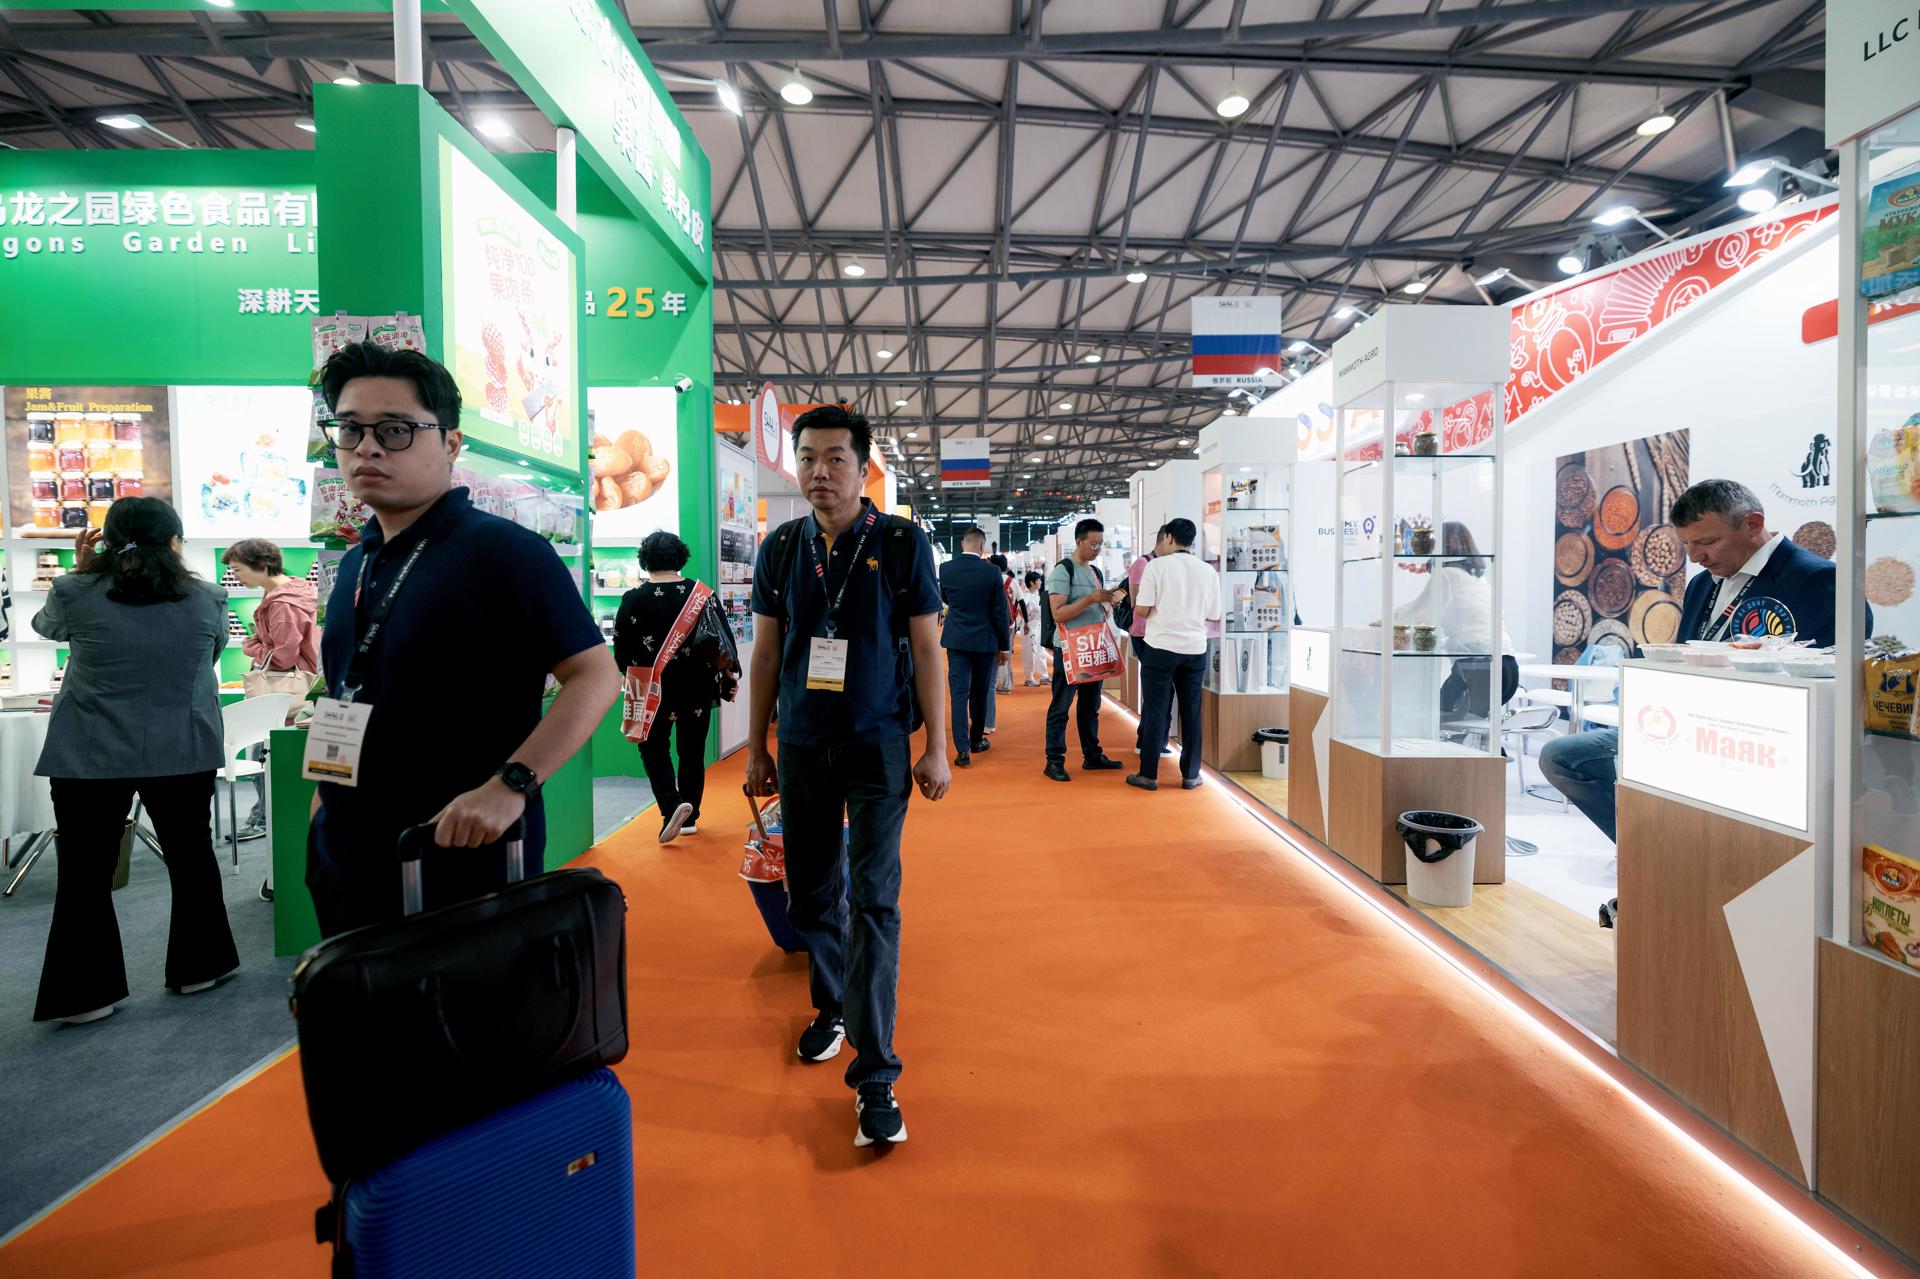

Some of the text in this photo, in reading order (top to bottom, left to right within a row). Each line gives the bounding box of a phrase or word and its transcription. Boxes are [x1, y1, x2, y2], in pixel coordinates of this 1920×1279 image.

[1863, 18, 1909, 61] LLC
[0, 190, 318, 227] 龙之园绿色食品有
[122, 231, 249, 253] Garden
[1338, 346, 1379, 378] MAMMOTH AGRO
[25, 402, 153, 413] Jam&Fruit Preparation
[1318, 527, 1360, 536] BUSESS
[1695, 726, 1776, 768] Маяк
